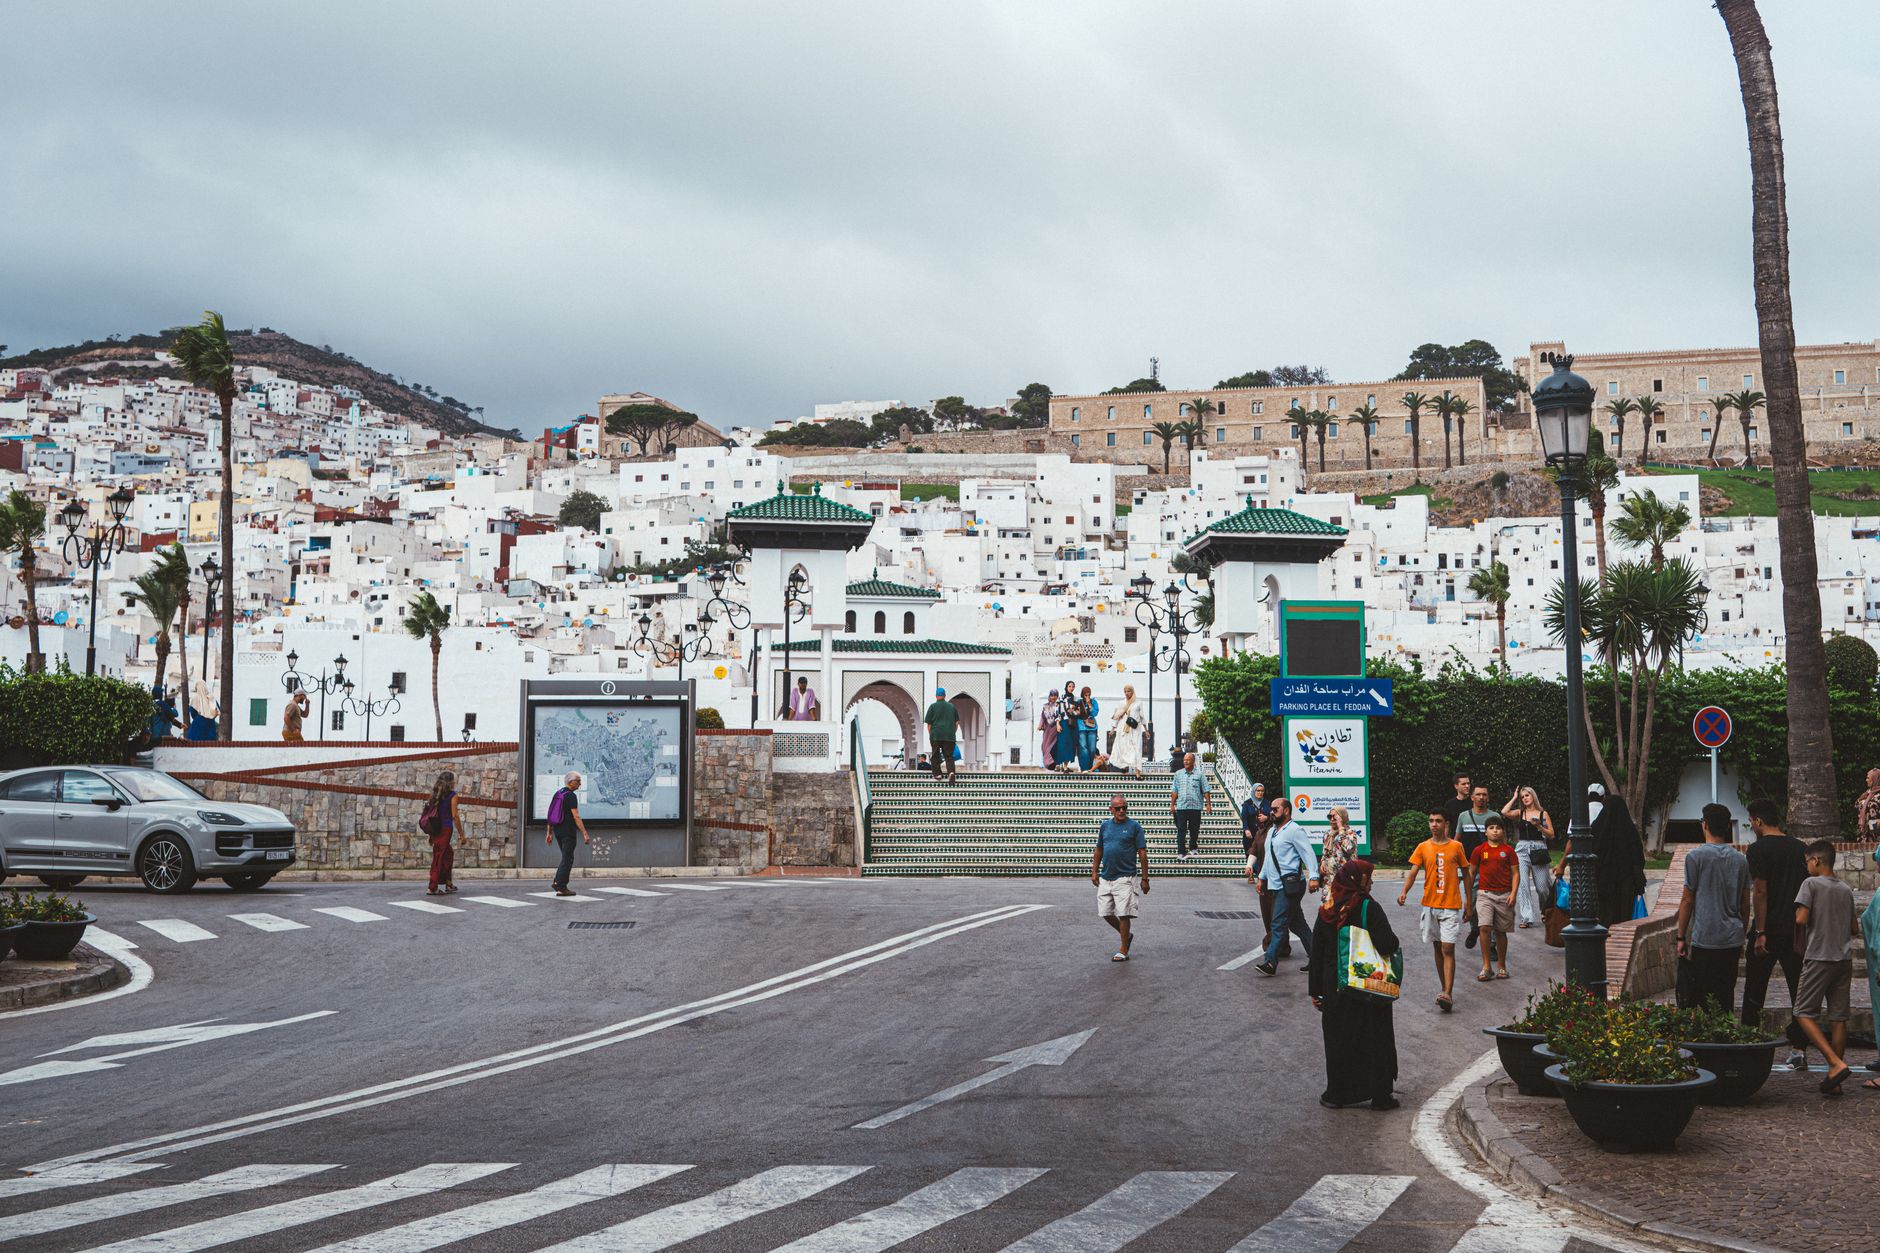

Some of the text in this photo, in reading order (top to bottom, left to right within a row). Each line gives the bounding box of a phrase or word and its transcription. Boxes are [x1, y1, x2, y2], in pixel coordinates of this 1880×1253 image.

[1283, 683, 1310, 697] الفدان
[1313, 682, 1338, 694] ساحة
[1279, 703, 1371, 711] PARKING PLACE EL FEDDAN
[1314, 727, 1352, 747] تطاون
